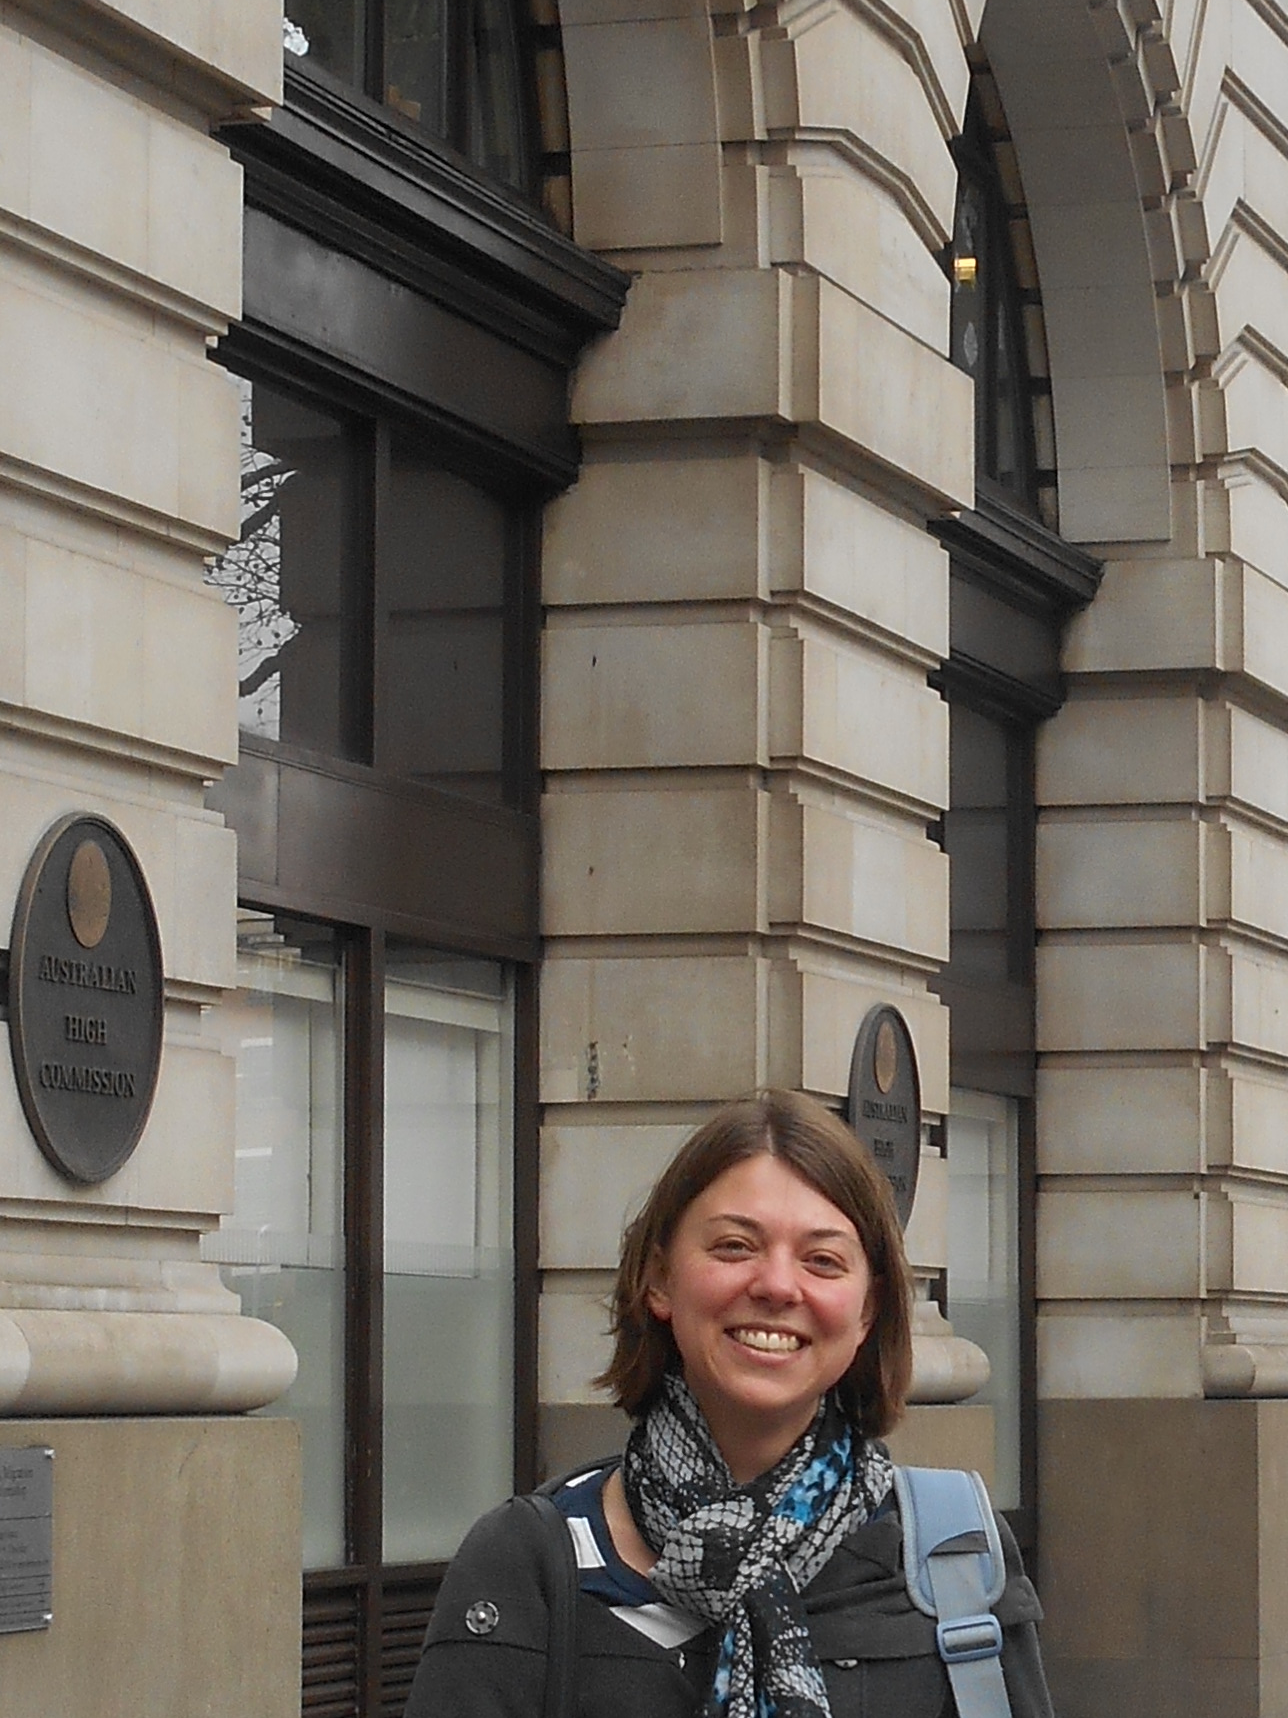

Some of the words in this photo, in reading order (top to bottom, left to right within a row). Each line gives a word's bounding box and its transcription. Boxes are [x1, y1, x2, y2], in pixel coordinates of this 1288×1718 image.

[39, 955, 136, 994] AUSTRALIAN
[65, 1014, 106, 1045] HIGH
[40, 1062, 135, 1098] COMMISSION
